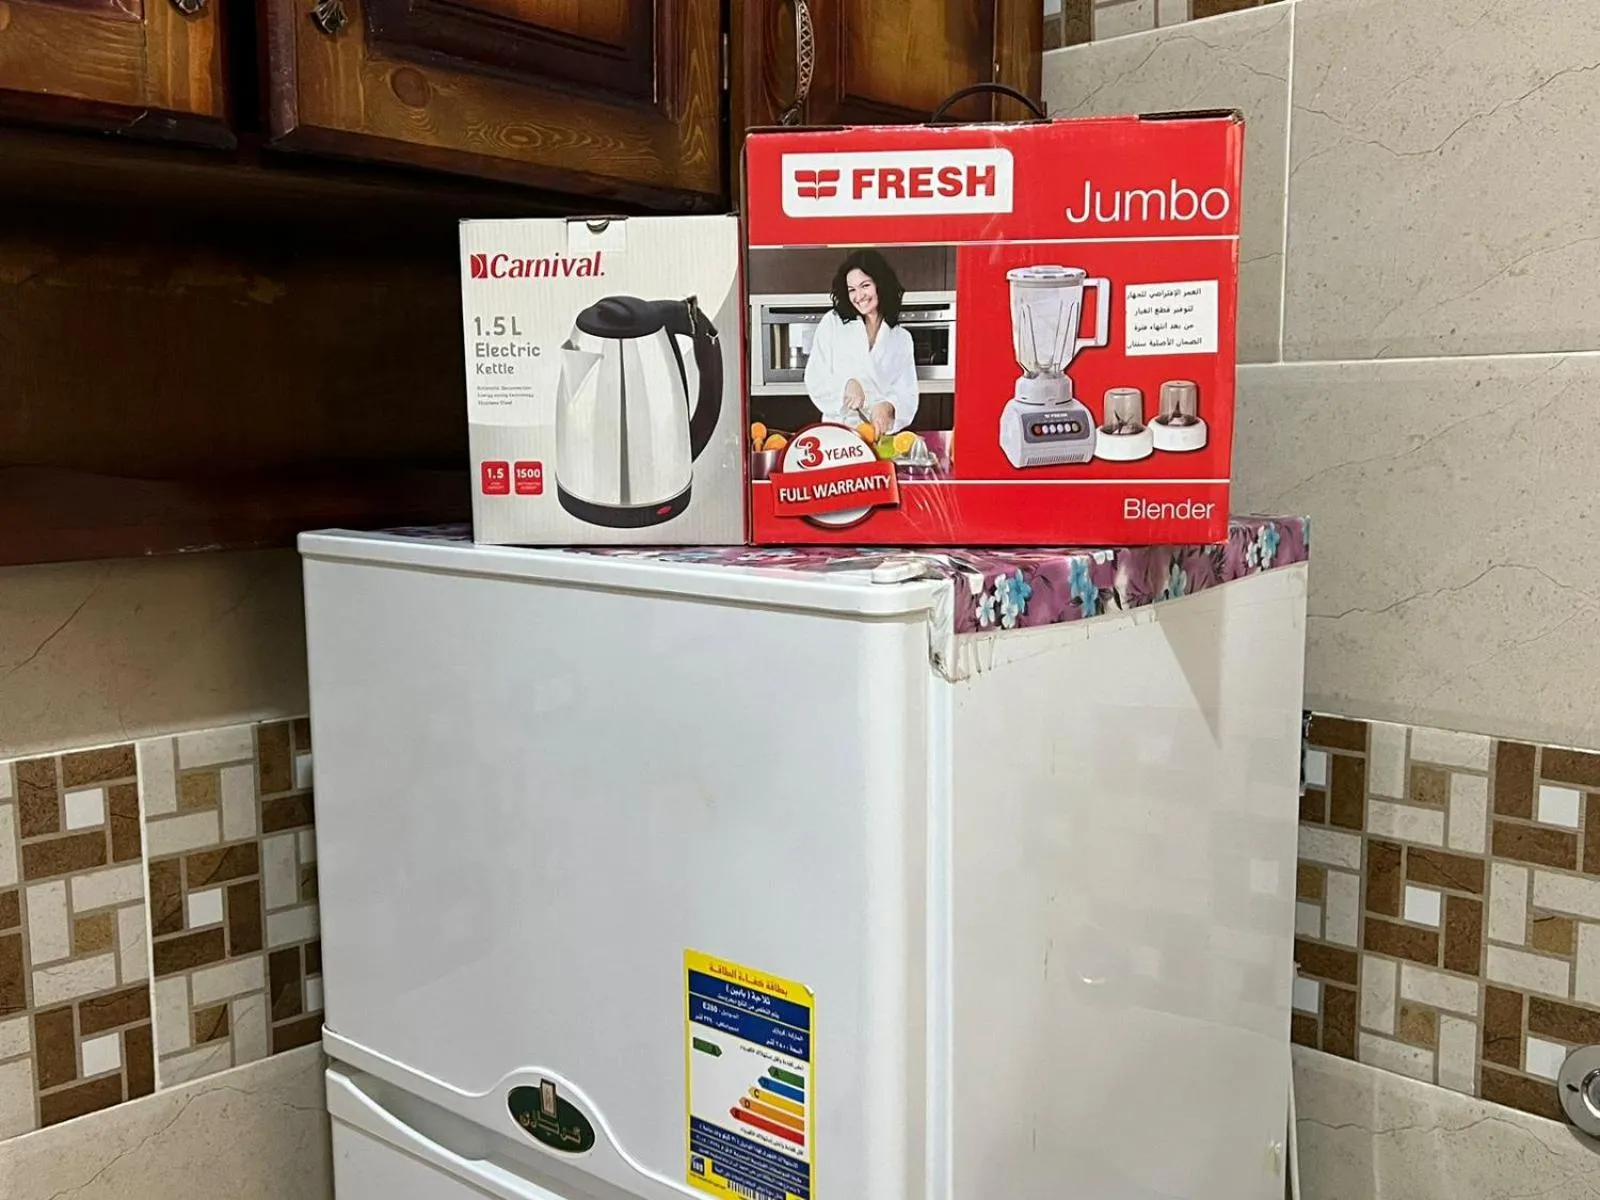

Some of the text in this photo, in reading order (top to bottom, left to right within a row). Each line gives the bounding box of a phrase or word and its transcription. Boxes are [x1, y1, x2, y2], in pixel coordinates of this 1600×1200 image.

[852, 164, 996, 200] FRESH
[1065, 178, 1230, 223] Jumbo
[474, 315, 522, 336] 1.5 L
[475, 341, 541, 357] Electric
[476, 362, 515, 375] Kettle
[795, 435, 864, 469] 3 YEARS
[487, 467, 505, 479] 1.5
[516, 468, 541, 479] 1500
[780, 475, 892, 502] FULL WARRANTY
[1123, 498, 1215, 520] Blender
